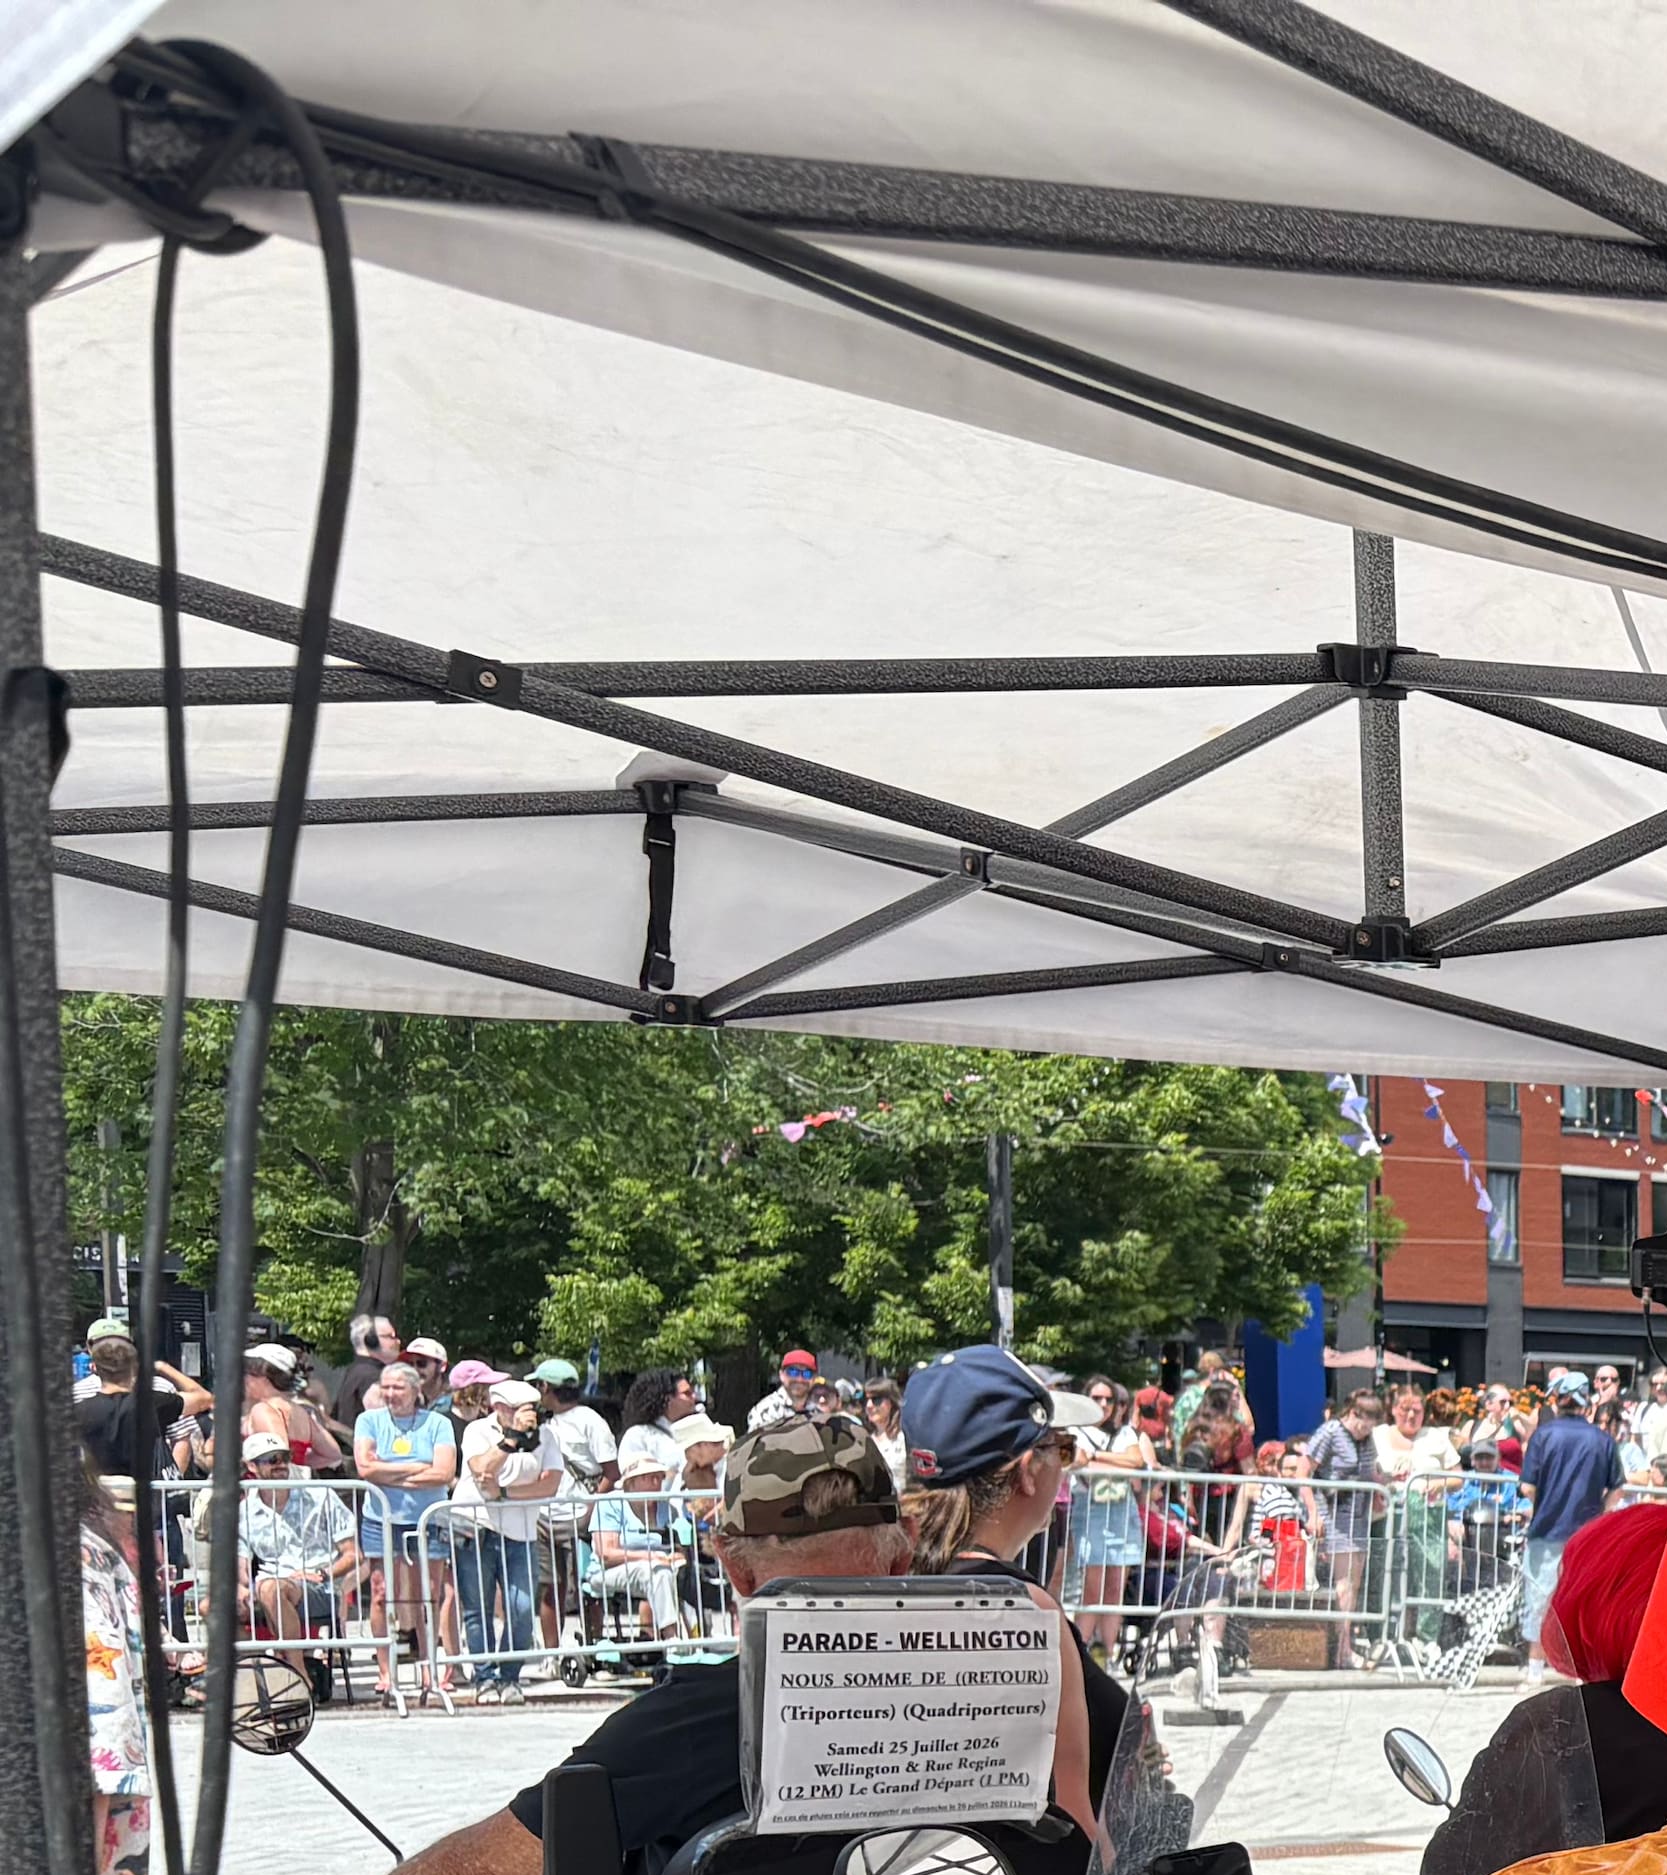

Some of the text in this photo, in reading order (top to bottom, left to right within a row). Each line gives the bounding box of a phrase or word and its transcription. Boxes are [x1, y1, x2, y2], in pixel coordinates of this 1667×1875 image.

[782, 1632, 878, 1652] PARADE
[900, 1629, 1048, 1650] WELLINGTON
[780, 1669, 1049, 1688] NOUS SOMME DE ((RETOUR))
[780, 1699, 1046, 1724] (Triporteurs) (Quadriporteurs)
[827, 1736, 1000, 1757] Samedi 25 Juillet 2026
[814, 1756, 1006, 1779] Wellington & Rue Regina
[777, 1772, 1031, 1801] (12 PM) Le Grand Départ (1 PM)
